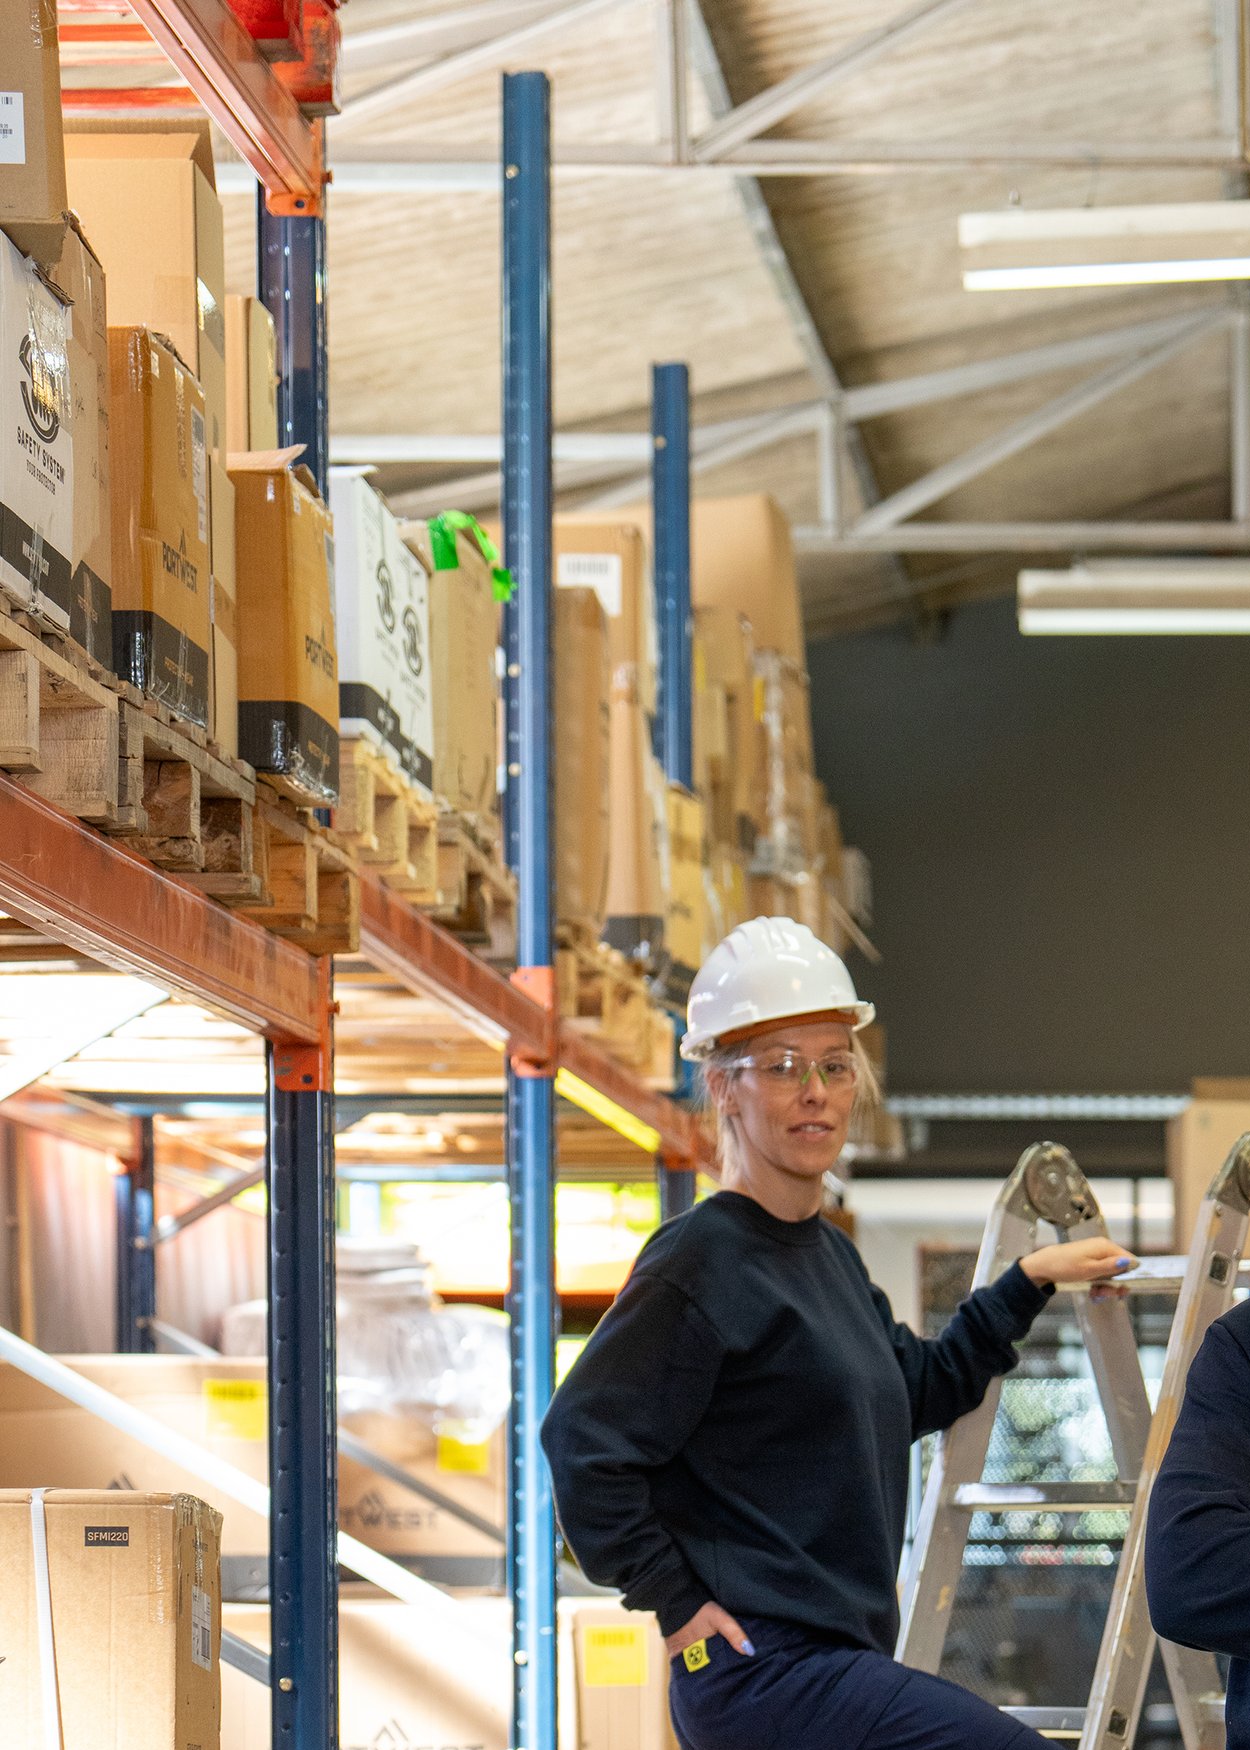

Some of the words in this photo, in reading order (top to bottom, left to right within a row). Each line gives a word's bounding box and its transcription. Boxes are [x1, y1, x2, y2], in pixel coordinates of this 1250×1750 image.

[17, 425, 40, 461] SAFETY
[42, 449, 65, 484] SYSTEM
[162, 540, 199, 594] PORTWEST
